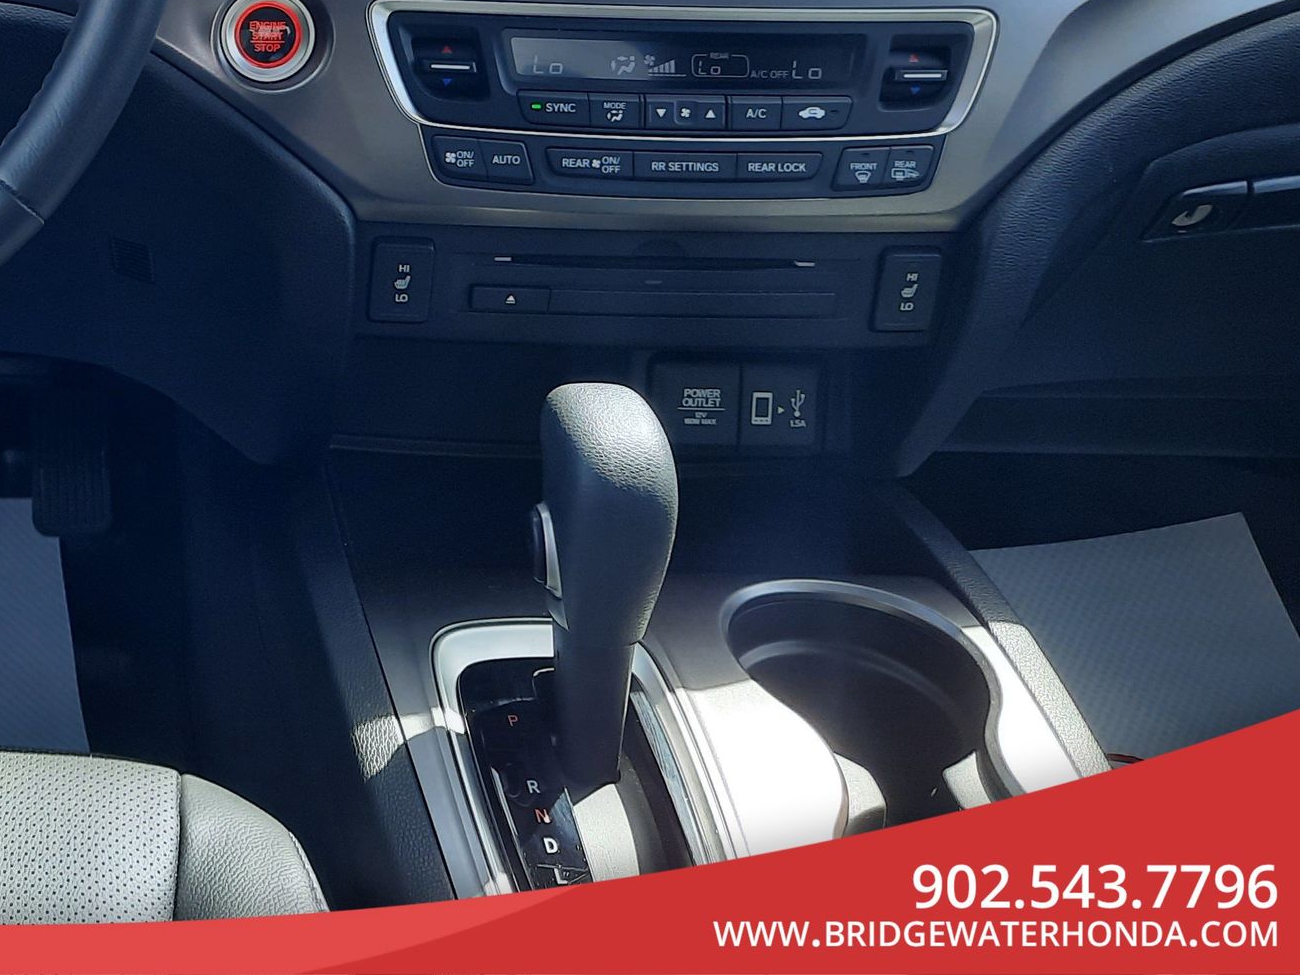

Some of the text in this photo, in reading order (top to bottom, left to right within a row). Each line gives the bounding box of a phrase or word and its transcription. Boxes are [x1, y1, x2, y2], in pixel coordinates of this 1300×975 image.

[249, 20, 287, 31] ENGINE
[254, 43, 281, 53] STOP
[545, 102, 577, 114] SYNC
[603, 101, 626, 110] MODE
[746, 108, 767, 119] A/C
[456, 159, 475, 168] OFF
[491, 154, 521, 165] AUTO
[562, 157, 590, 169] REAR
[894, 160, 917, 169] REAR
[601, 164, 621, 174] OFF
[651, 160, 719, 173] RR SETTINGS
[748, 162, 806, 173] REAR LOCK
[850, 162, 878, 171] FRONT
[398, 264, 411, 273] HI
[683, 388, 721, 398] POWER
[681, 398, 722, 408] OUTLET
[507, 714, 518, 727] P
[526, 780, 540, 794] R
[534, 808, 550, 823] N
[543, 837, 559, 854] D
